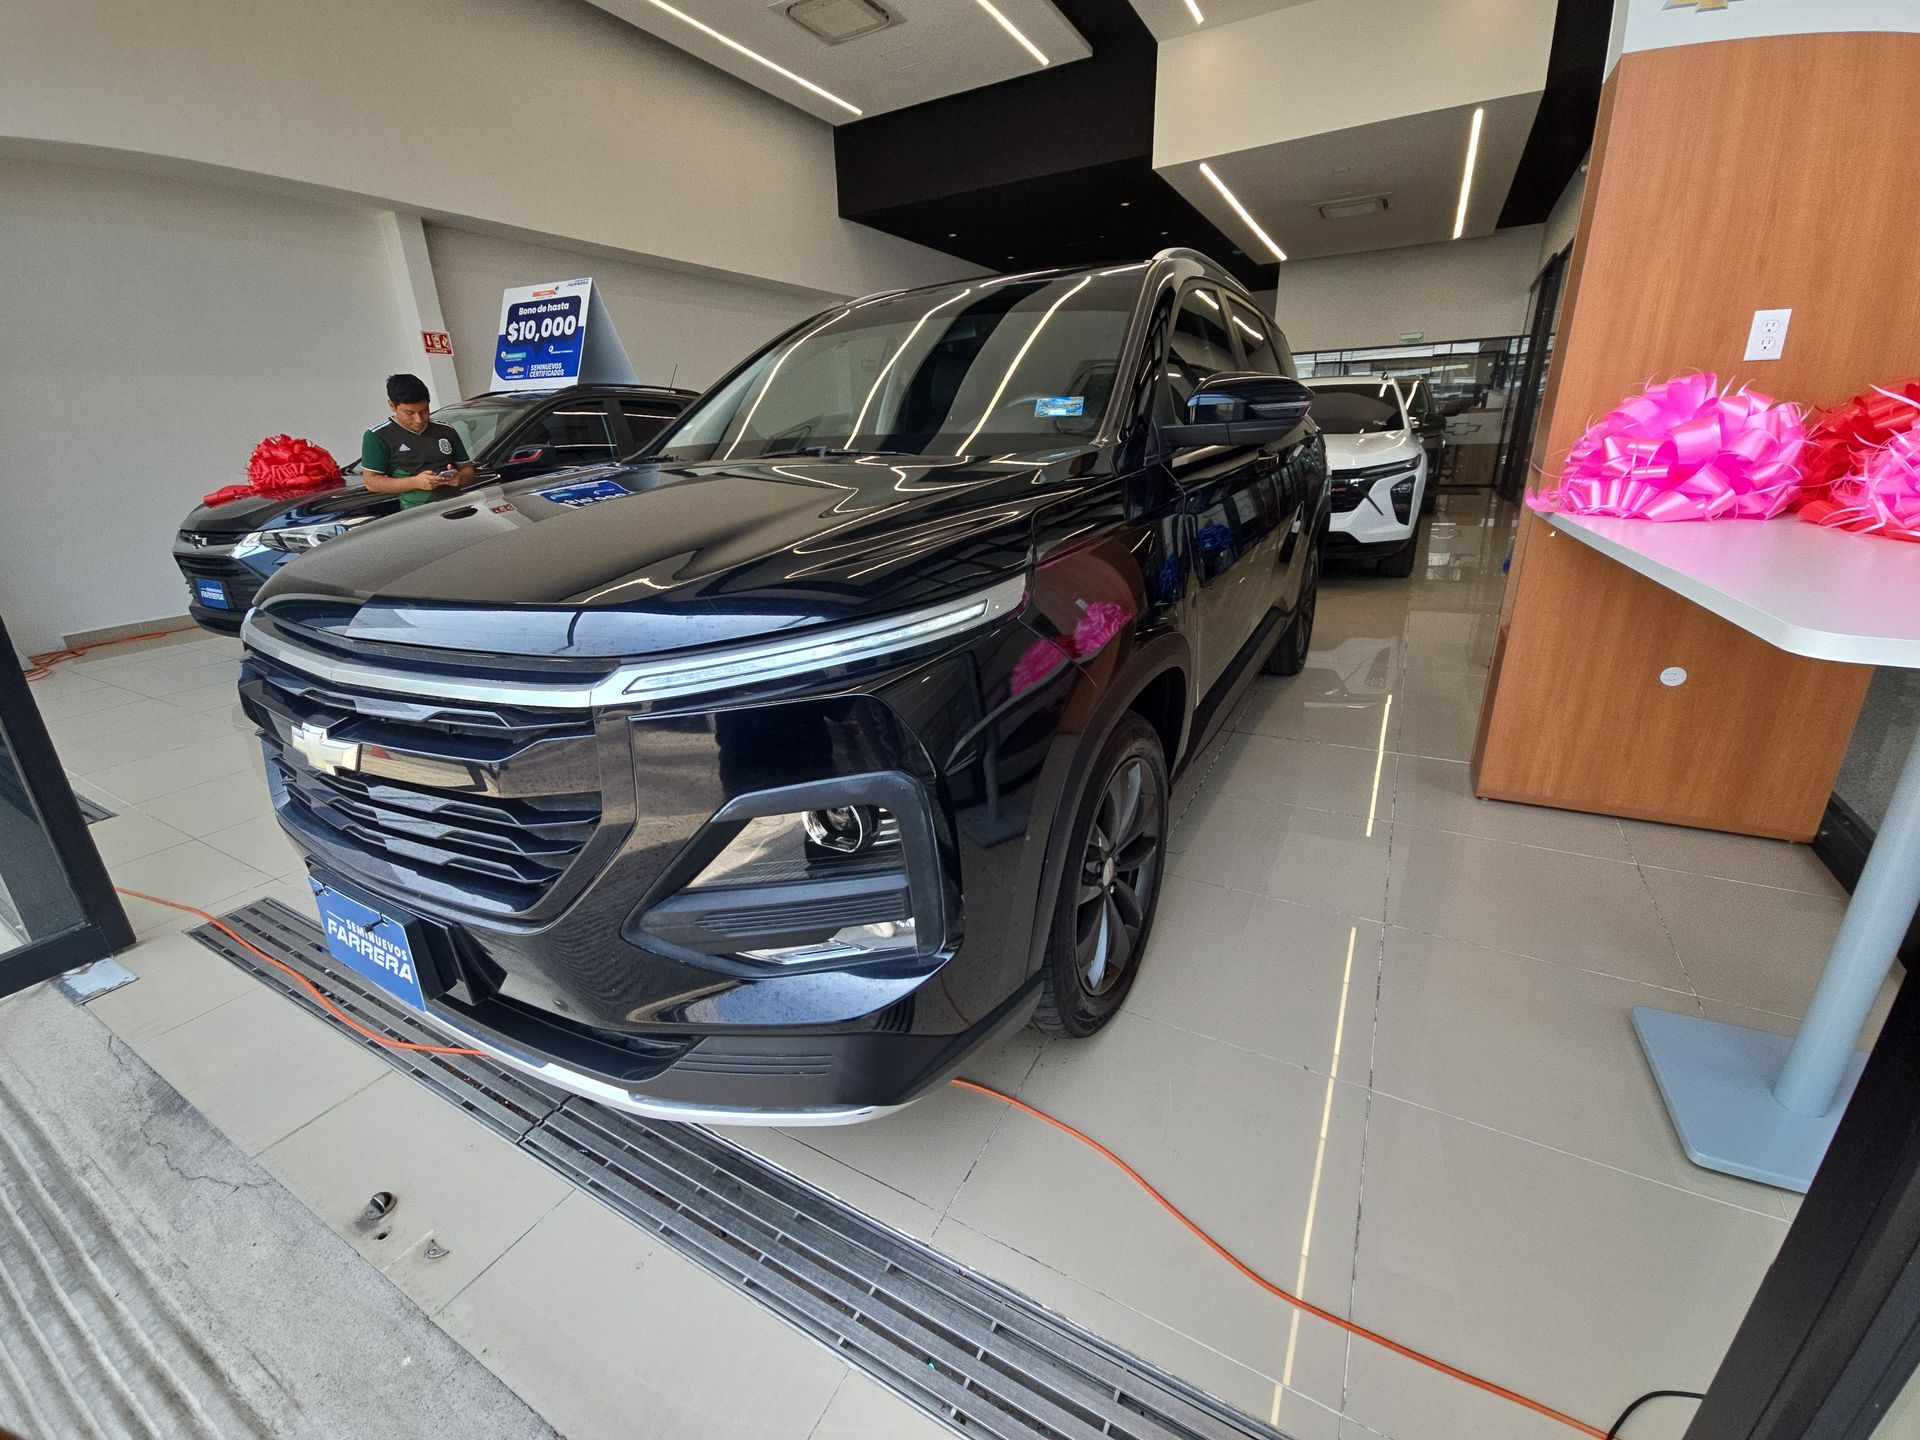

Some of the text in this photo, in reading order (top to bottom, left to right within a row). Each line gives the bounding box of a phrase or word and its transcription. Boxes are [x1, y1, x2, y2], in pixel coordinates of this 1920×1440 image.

[518, 301, 570, 316] Bono de hasta
[507, 315, 577, 343] $10,000
[529, 369, 565, 378] CERTIFICADOS
[530, 362, 562, 371] SEMINUEVOS
[327, 917, 414, 985] FARRERA
[346, 919, 408, 962] SEMINUEVOS
